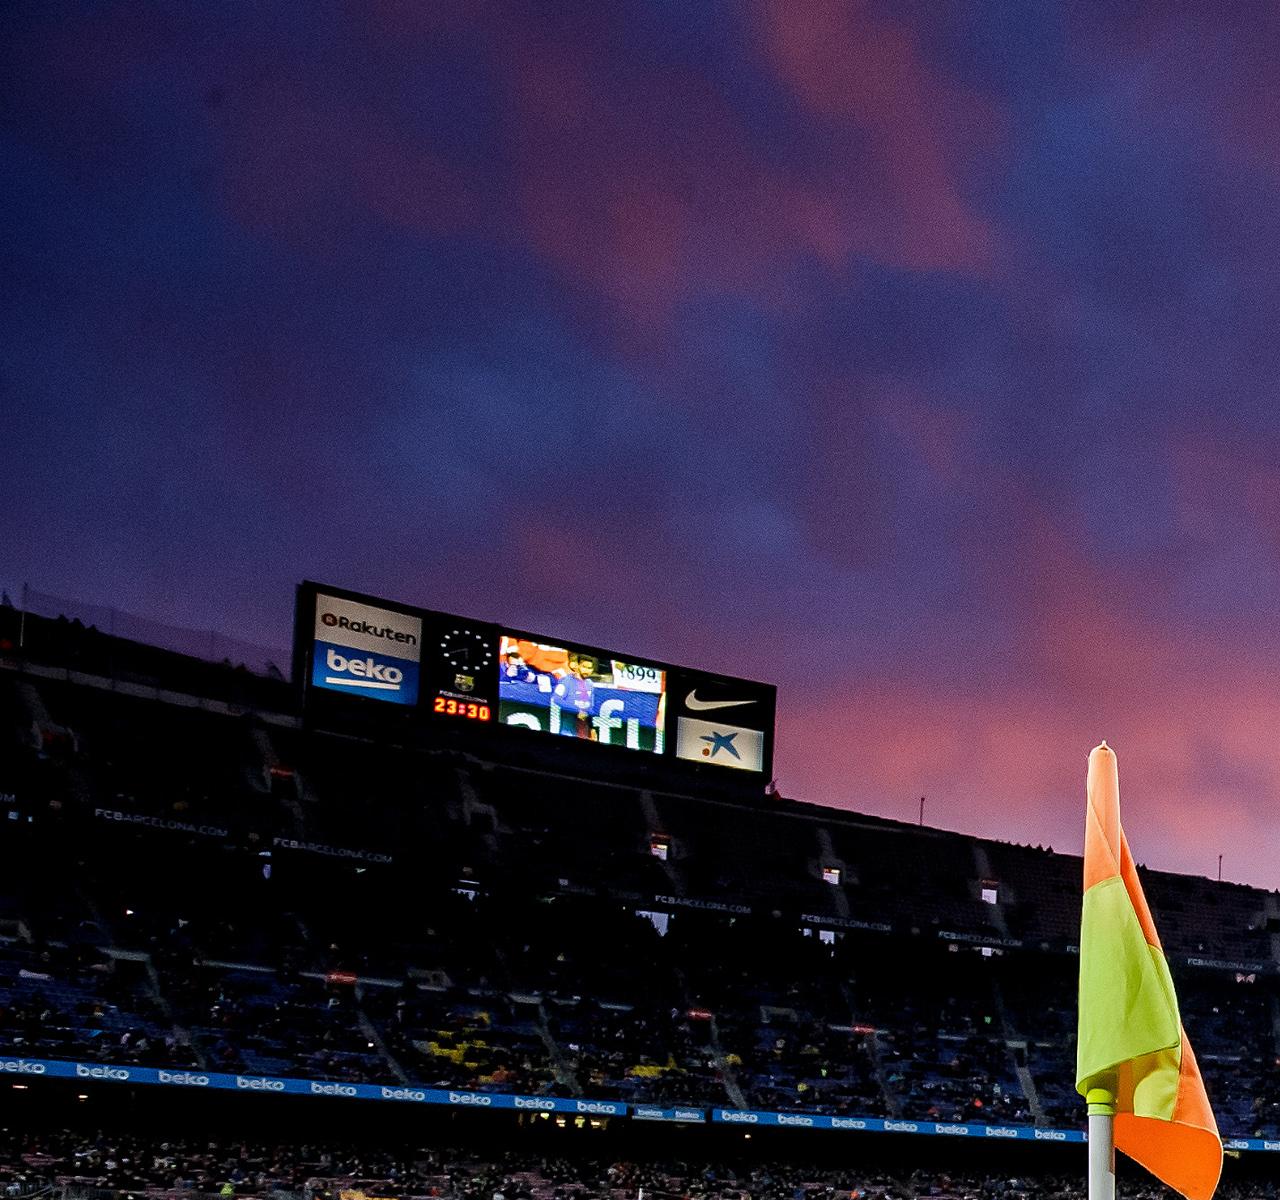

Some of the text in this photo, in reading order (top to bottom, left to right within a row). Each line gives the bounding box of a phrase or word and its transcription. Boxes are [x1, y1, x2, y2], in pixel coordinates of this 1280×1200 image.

[338, 616, 417, 645] Rakuten
[326, 648, 403, 684] beko
[434, 696, 491, 721] 23:30
[94, 808, 229, 837] FCBARCELONA.COM
[77, 1063, 129, 1080] beko
[159, 1070, 209, 1086] beko
[237, 1076, 284, 1091] beko
[311, 1081, 356, 1096] beko
[382, 1087, 425, 1101] beko
[449, 1092, 491, 1105] beko
[515, 1096, 555, 1110] beko
[577, 1101, 615, 1114] beko
[721, 1111, 1066, 1140] beko beko beko beko beko beko beko
